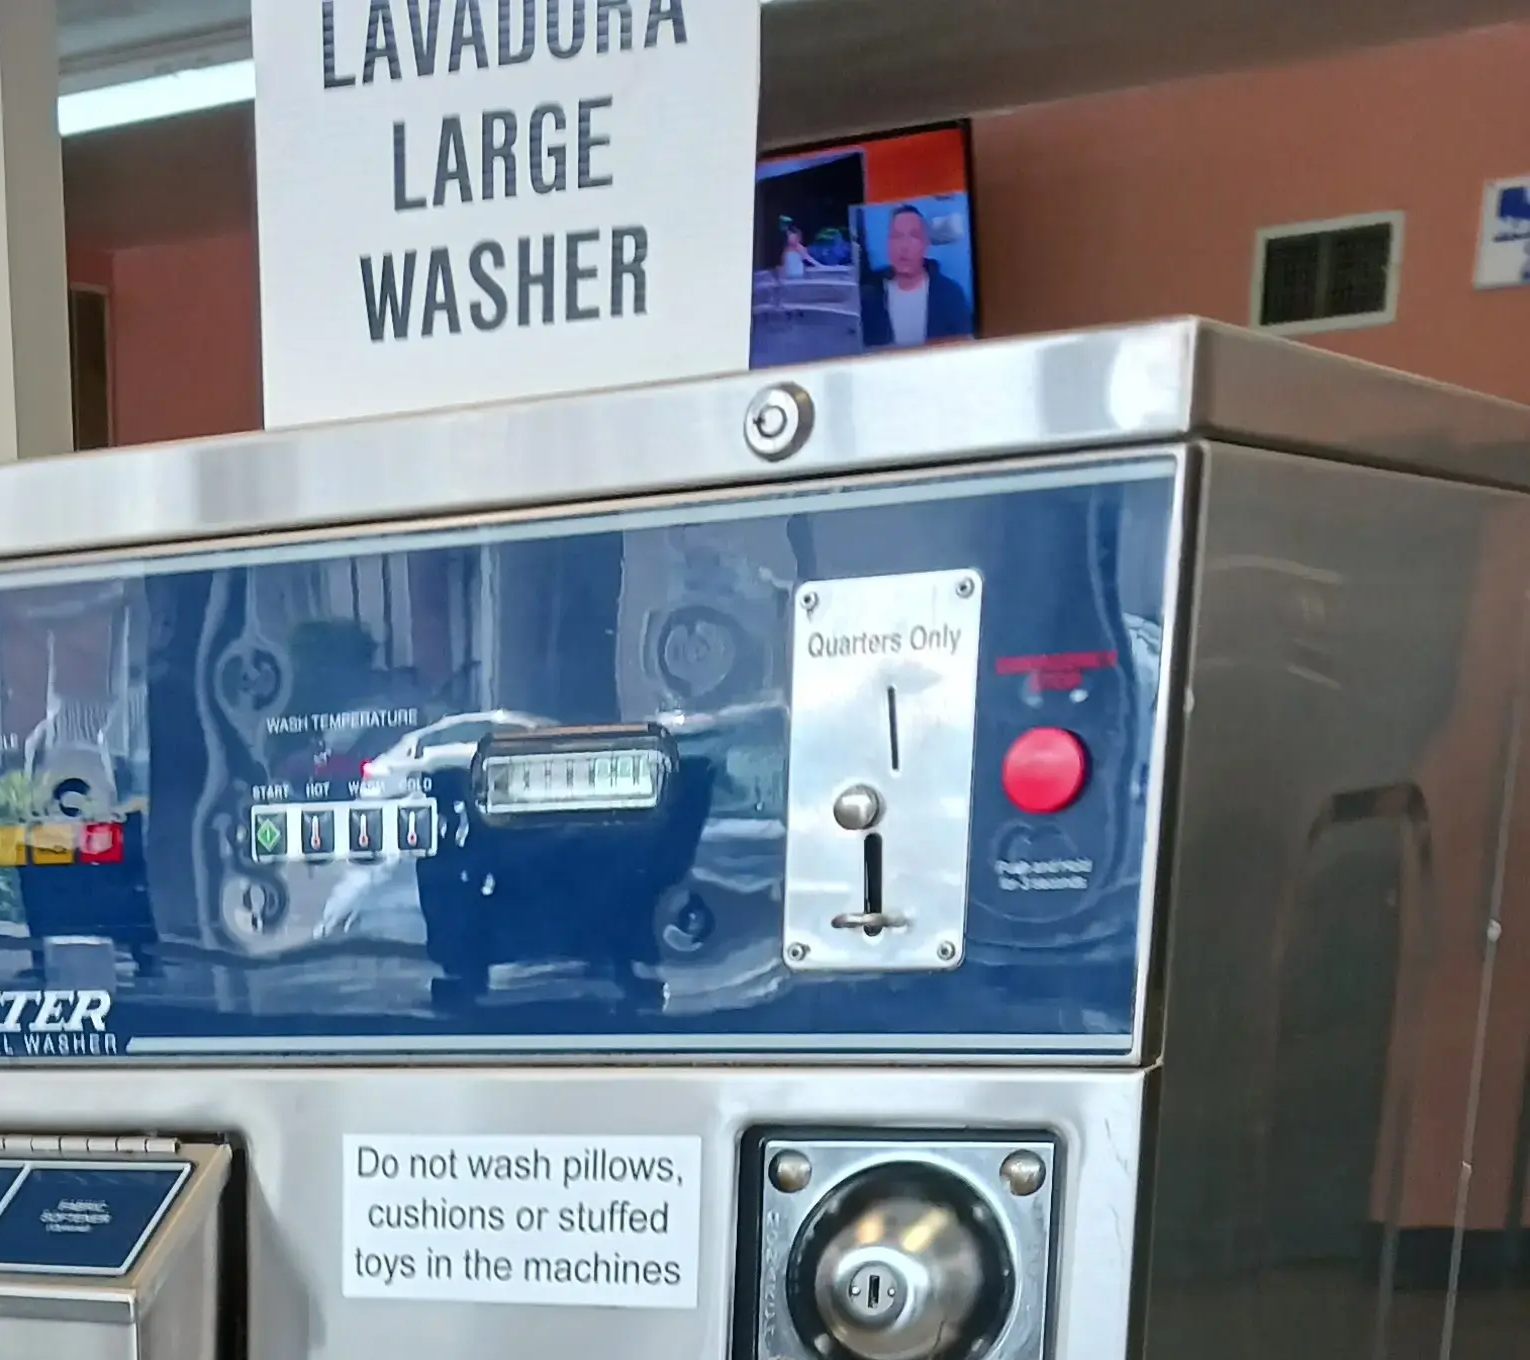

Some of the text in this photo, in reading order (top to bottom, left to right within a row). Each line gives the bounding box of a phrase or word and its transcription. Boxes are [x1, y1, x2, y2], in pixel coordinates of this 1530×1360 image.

[323, 0, 688, 88] LAVADORA
[393, 95, 614, 211] LARGE
[360, 225, 650, 341] WASHER
[807, 624, 962, 658] Quarters Only
[312, 708, 418, 731] TEMPERATURE
[252, 784, 290, 800] START
[305, 782, 330, 798] HOT
[24, 1033, 118, 1055] WASHER
[356, 1146, 684, 1189] Do not wash pillows,
[368, 1197, 669, 1234] cushions or stuffed
[355, 1247, 682, 1287] toys in the machines
